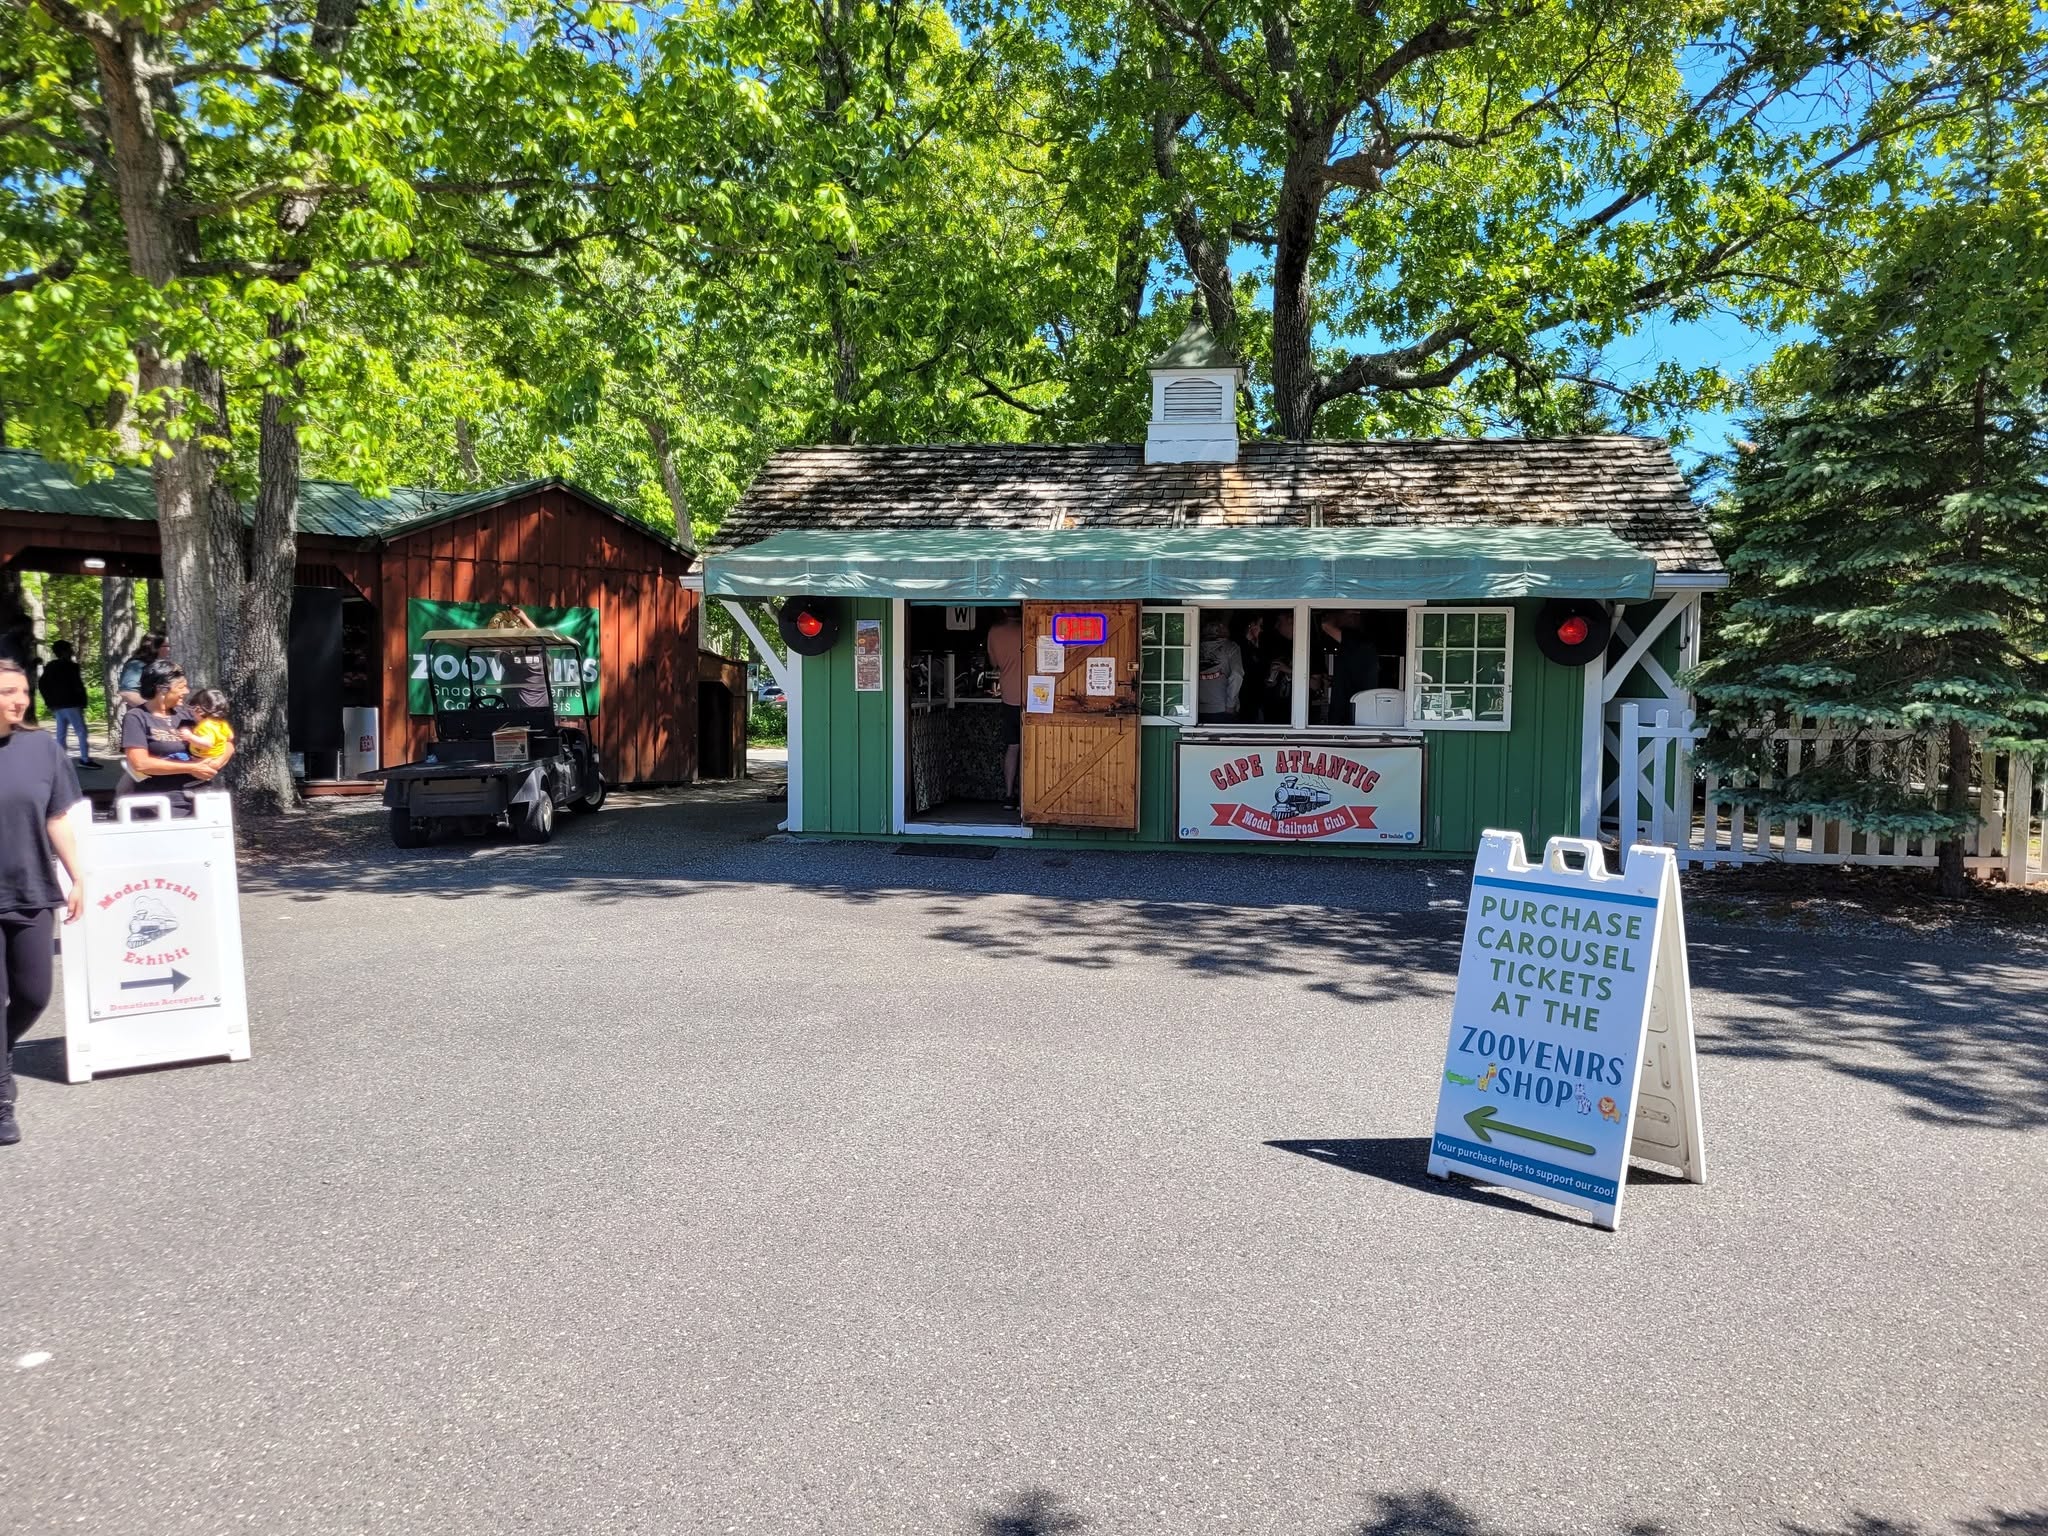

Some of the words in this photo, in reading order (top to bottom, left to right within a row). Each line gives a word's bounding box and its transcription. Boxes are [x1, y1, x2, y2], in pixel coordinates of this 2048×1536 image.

[955, 607, 968, 623] W
[1056, 616, 1103, 640] OPEN
[411, 654, 598, 682] ZOOVIRS
[1210, 754, 1264, 791] CAPE
[1275, 750, 1380, 793] ATLANTIC
[1242, 811, 1272, 832] Model
[1277, 820, 1319, 835] Railroad
[1323, 814, 1346, 830] Club
[97, 879, 150, 910] Model
[155, 878, 199, 901] Train
[1481, 895, 1642, 940] PURCHASE
[123, 947, 190, 966] Exhibit
[1478, 926, 1636, 972] CAROUSEL
[1490, 958, 1612, 1001] TICKETS
[1491, 991, 1531, 1017] AT
[1543, 998, 1600, 1032] THE
[1458, 1025, 1624, 1086] ZOOVENIRS
[1495, 1066, 1574, 1108] SHOP
[1437, 1141, 1456, 1153] Your
[1457, 1147, 1498, 1165] purchase
[1498, 1156, 1523, 1173] helps
[1525, 1164, 1535, 1175] to
[1536, 1169, 1574, 1185] support
[1575, 1181, 1592, 1191] our
[1593, 1185, 1615, 1198] zoo!
